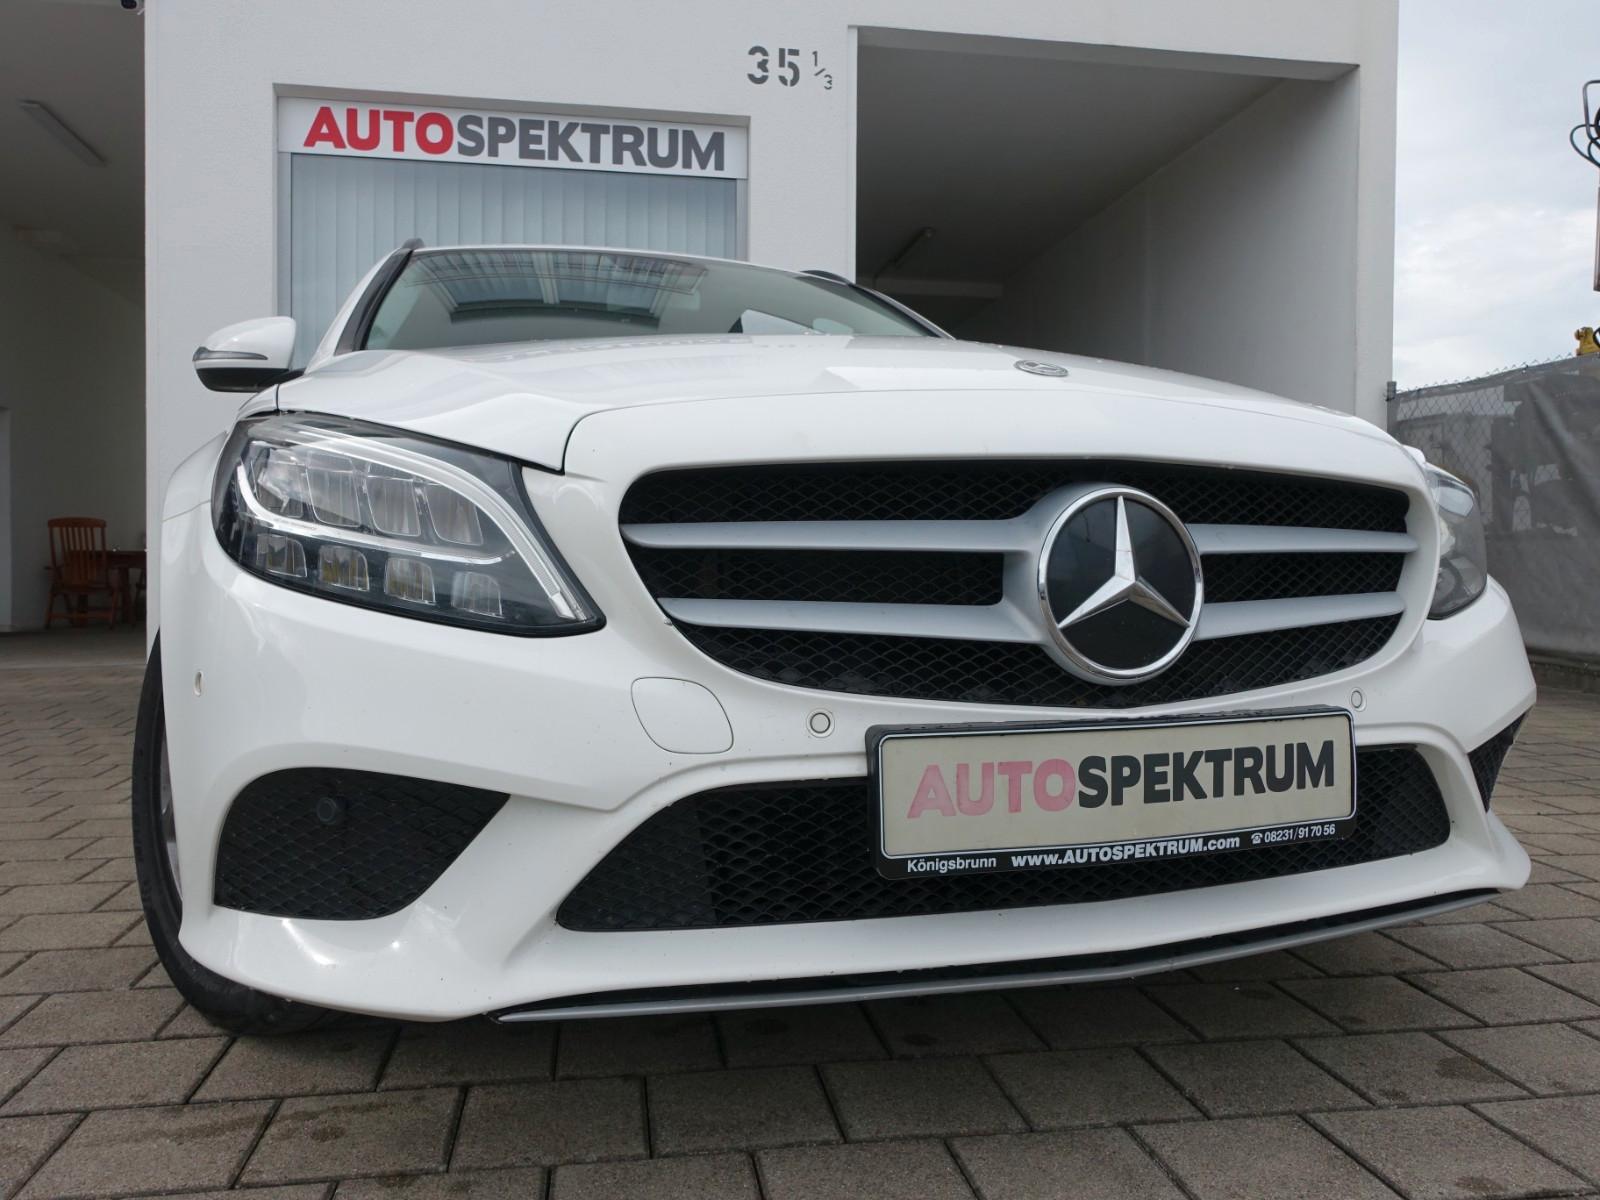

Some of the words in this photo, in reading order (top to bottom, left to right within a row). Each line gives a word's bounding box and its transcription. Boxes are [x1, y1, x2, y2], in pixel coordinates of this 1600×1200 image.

[747, 45, 800, 87] 35
[303, 106, 725, 171] AUTOSPEKTRUM
[907, 740, 1335, 819] AUTOSPEKTRUM
[907, 857, 997, 874] Königsbrunn
[1011, 836, 1240, 868] www.AUTOSPEKTRUM.com
